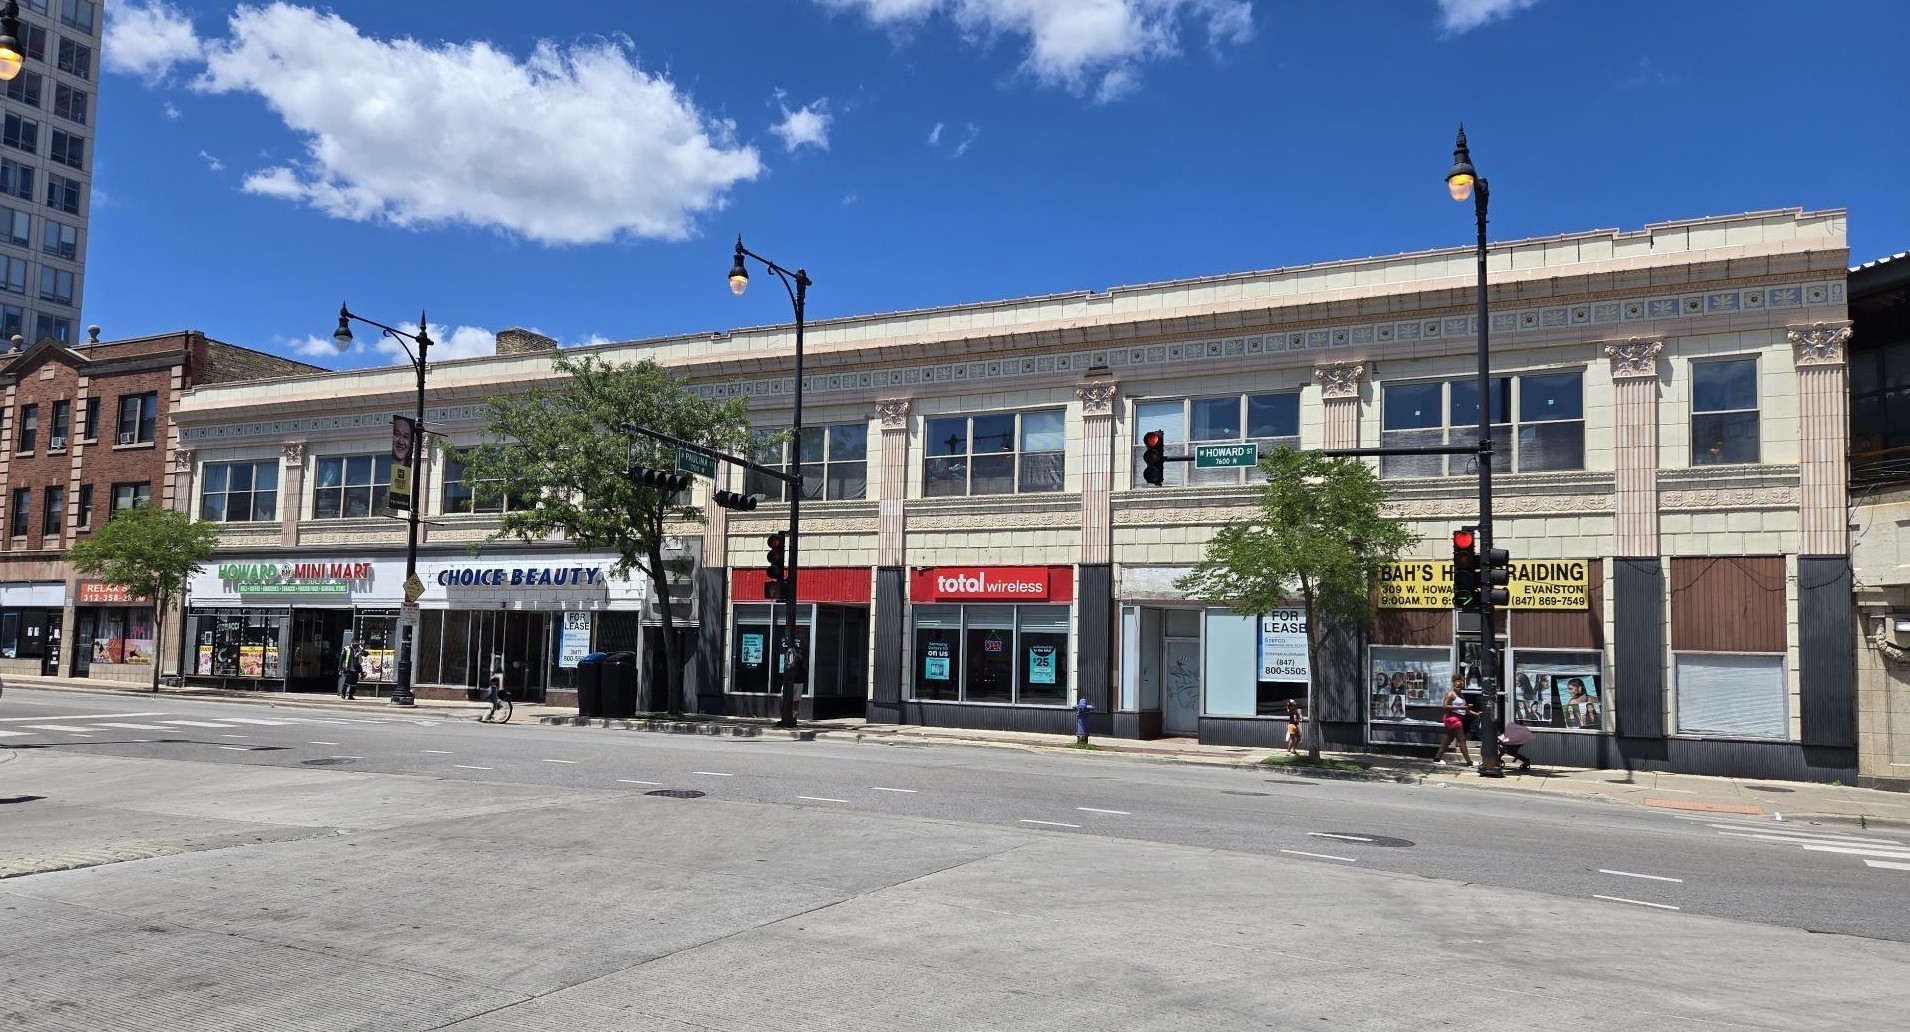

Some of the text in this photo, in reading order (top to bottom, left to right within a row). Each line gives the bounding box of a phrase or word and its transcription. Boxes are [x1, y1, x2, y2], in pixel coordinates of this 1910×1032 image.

[1206, 448, 1244, 457] HOWARD
[686, 453, 708, 466] PAULINA
[218, 562, 371, 580] HOWARD MINI MART
[1381, 564, 1433, 582] BAH'S
[1506, 563, 1584, 582] RAIDING
[437, 567, 600, 587] CHOICE BEAUTY
[938, 571, 1043, 593] total wireless
[87, 584, 119, 593] RELAX
[1382, 585, 1584, 594] 309 W. HOWA EVANSTON
[1381, 596, 1420, 605] 9:00AM
[1424, 596, 1437, 605] TO
[1512, 596, 1535, 606] (847)
[1538, 596, 1585, 606] 869-7549
[569, 612, 586, 621] FOR
[1272, 610, 1299, 621] FOR
[564, 622, 590, 630] LEASE
[1264, 622, 1307, 634] LEASE
[1033, 657, 1050, 667] $25
[1265, 666, 1307, 675] 800-5505
